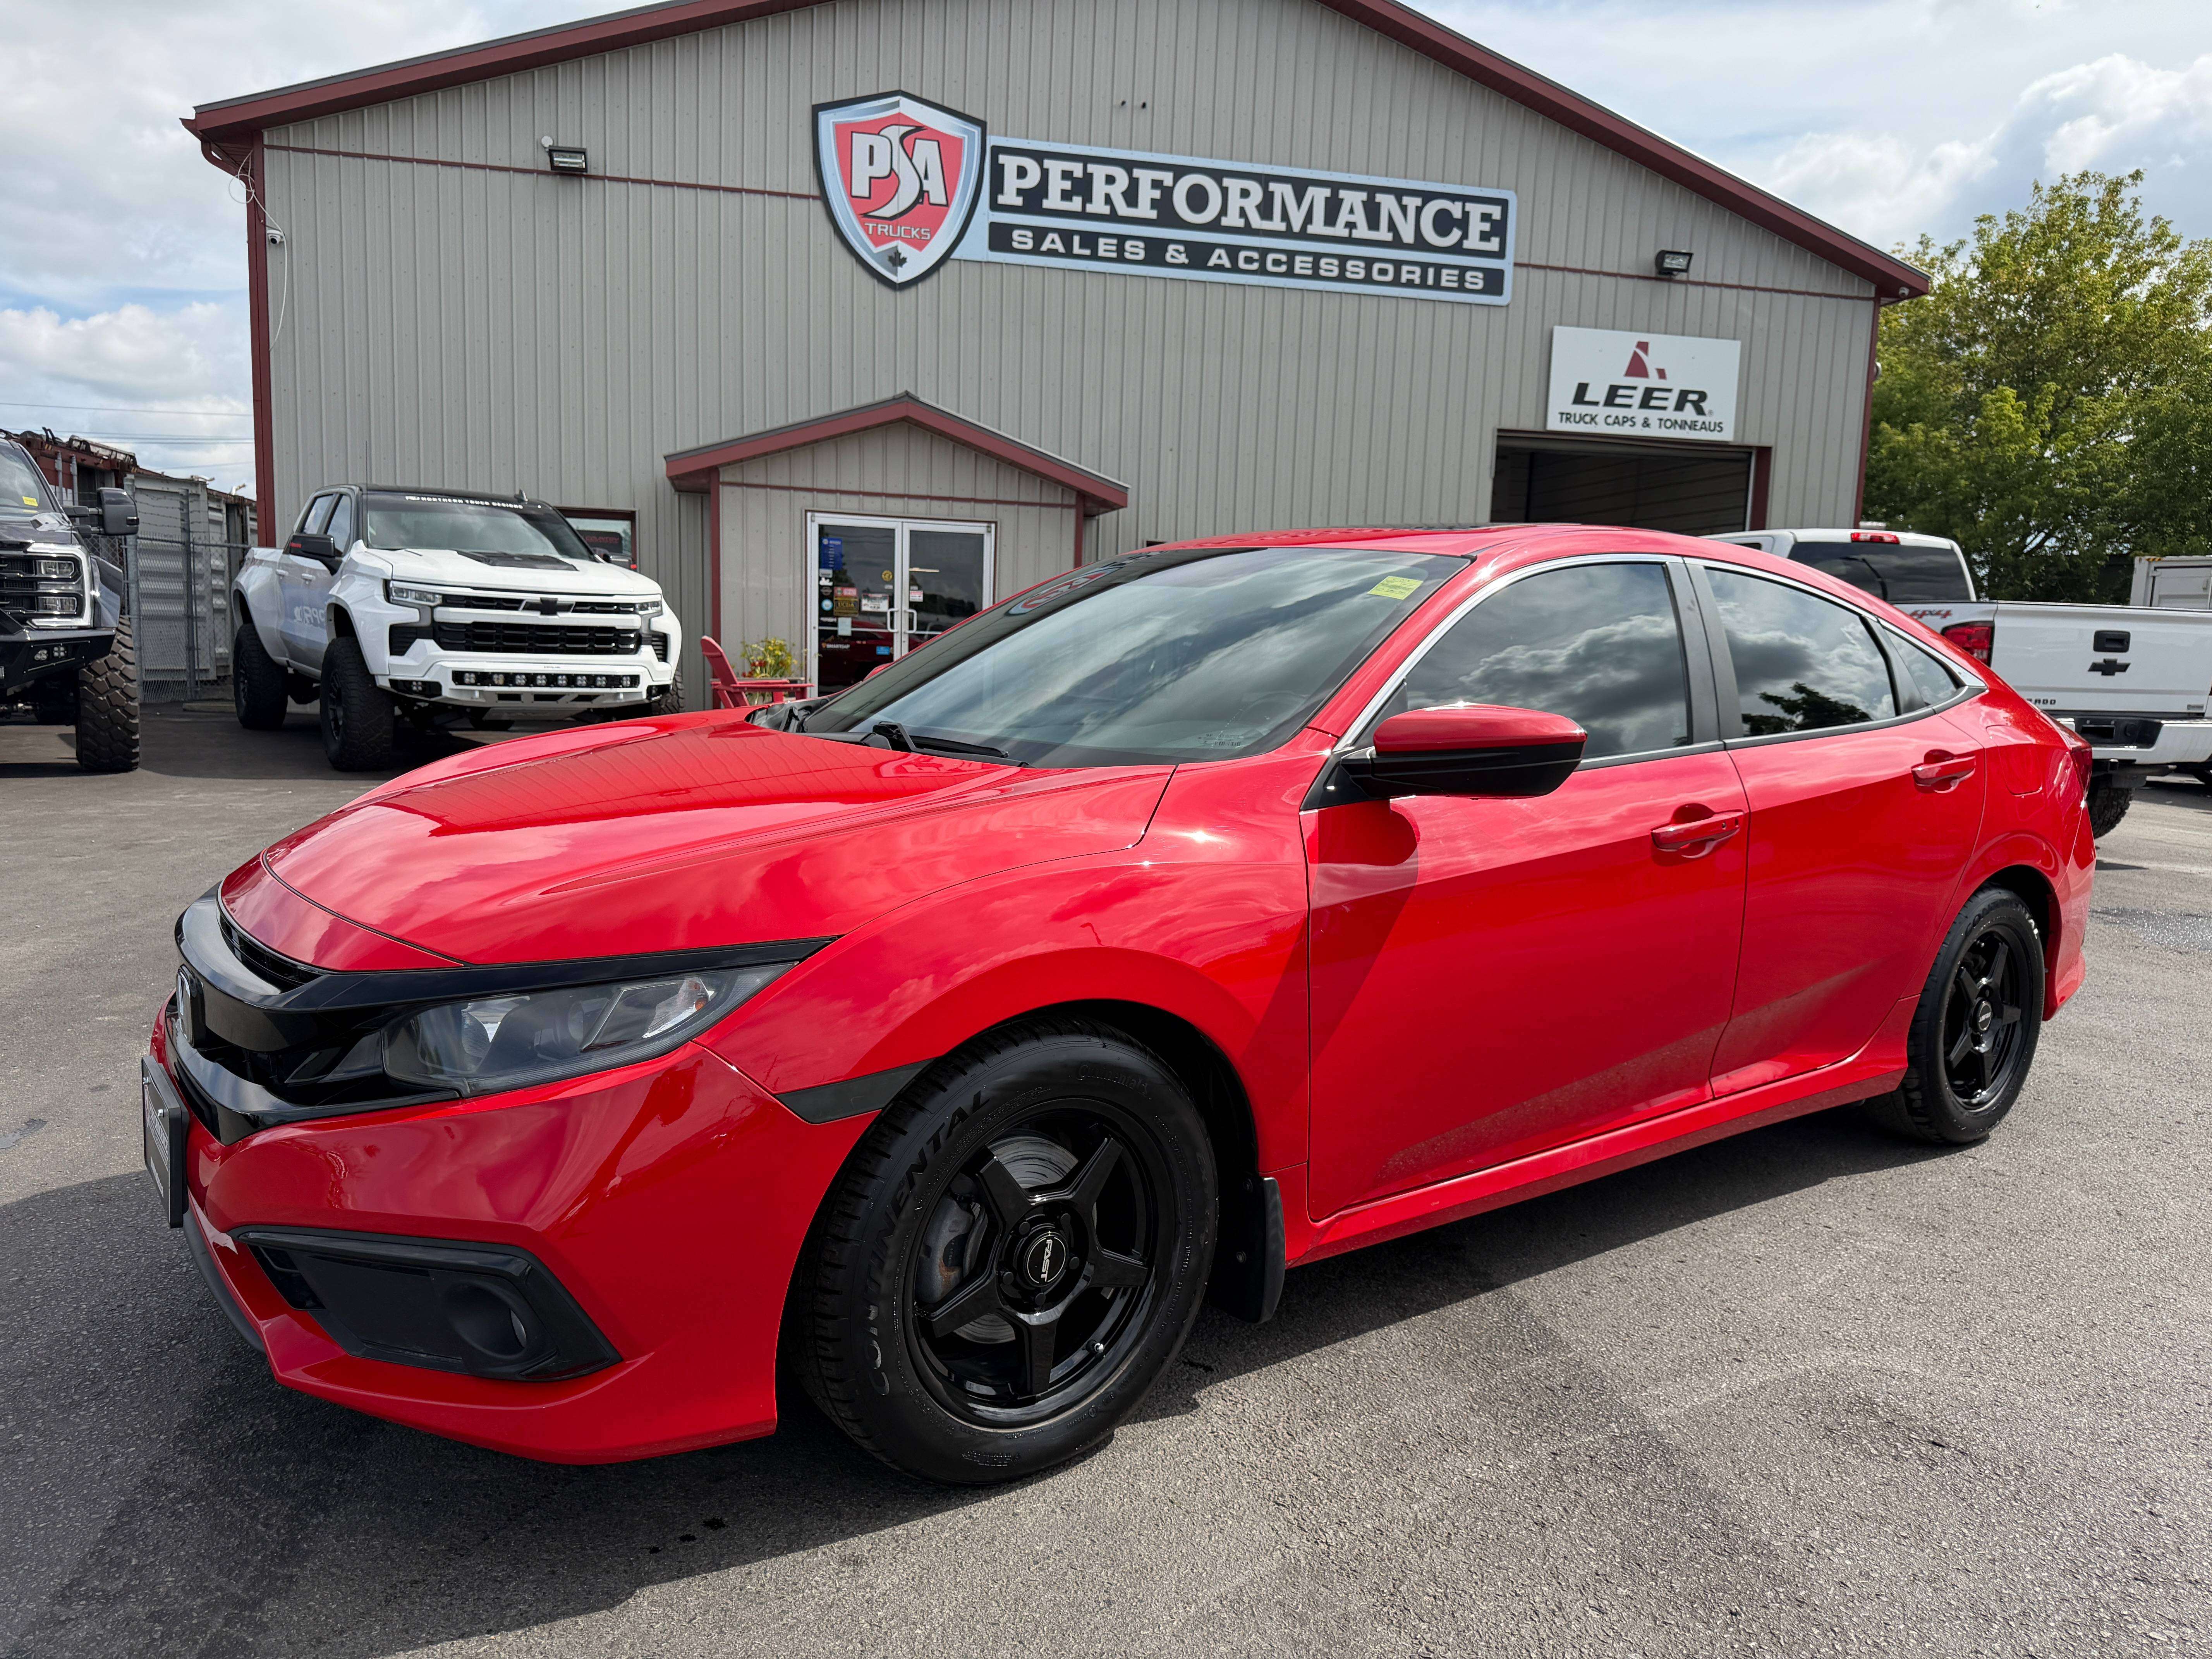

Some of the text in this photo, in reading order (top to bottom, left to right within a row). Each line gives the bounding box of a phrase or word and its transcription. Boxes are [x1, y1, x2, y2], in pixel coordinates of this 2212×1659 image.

[850, 124, 949, 220] PSA
[997, 154, 1502, 252] PERFORMANCE
[864, 222, 931, 240] TRUCKS
[1011, 229, 1484, 290] SALES & ACCESSORIES
[1558, 412, 1723, 433] TRUCK CAPS & TONNEAUS
[1571, 382, 1708, 417] LEER
[863, 1090, 991, 1395] CONTINENTAL
[1041, 1239, 1053, 1282] FAST
